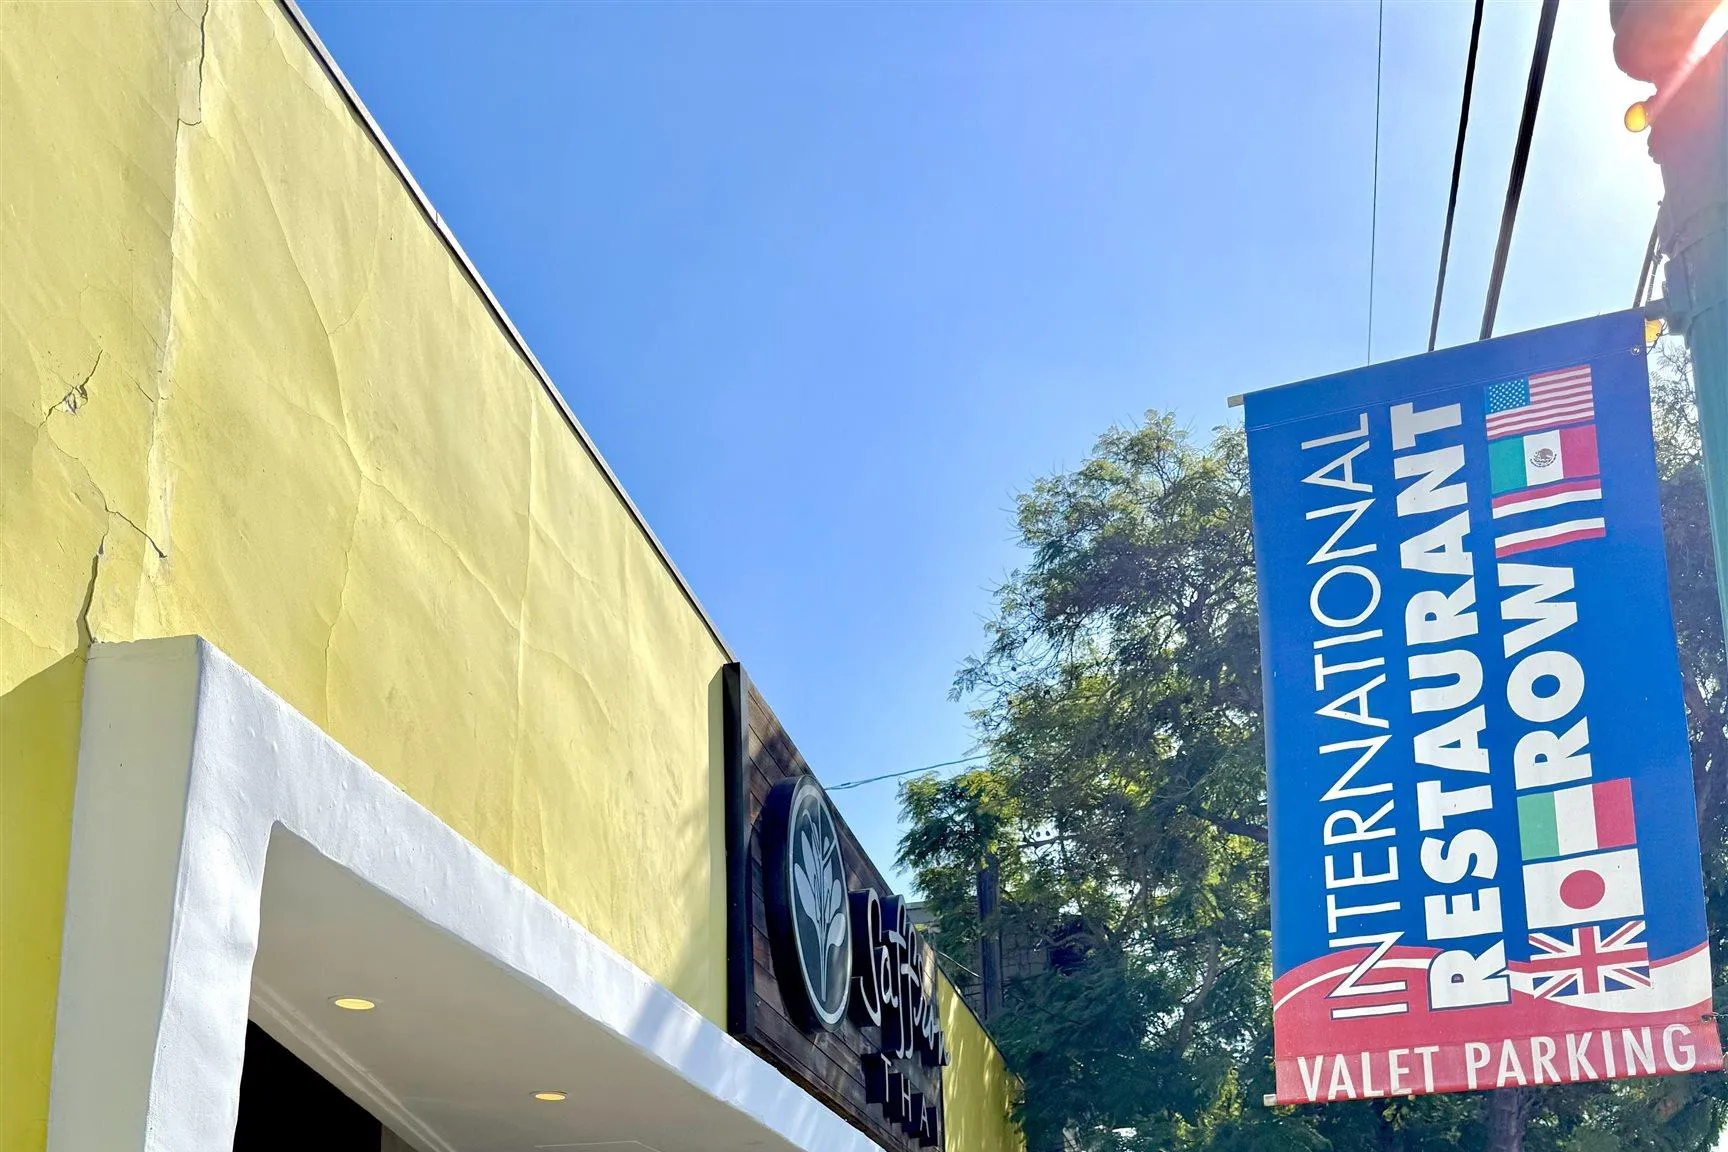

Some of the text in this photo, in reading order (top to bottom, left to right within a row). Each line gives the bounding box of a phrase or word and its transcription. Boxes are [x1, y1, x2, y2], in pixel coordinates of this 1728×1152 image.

[1301, 413, 1409, 1020] INTERNATIONAL
[1390, 402, 1511, 1011] RESTAURANT
[1497, 562, 1593, 790] ROW
[1297, 1023, 1697, 1102] VALET PARKING
